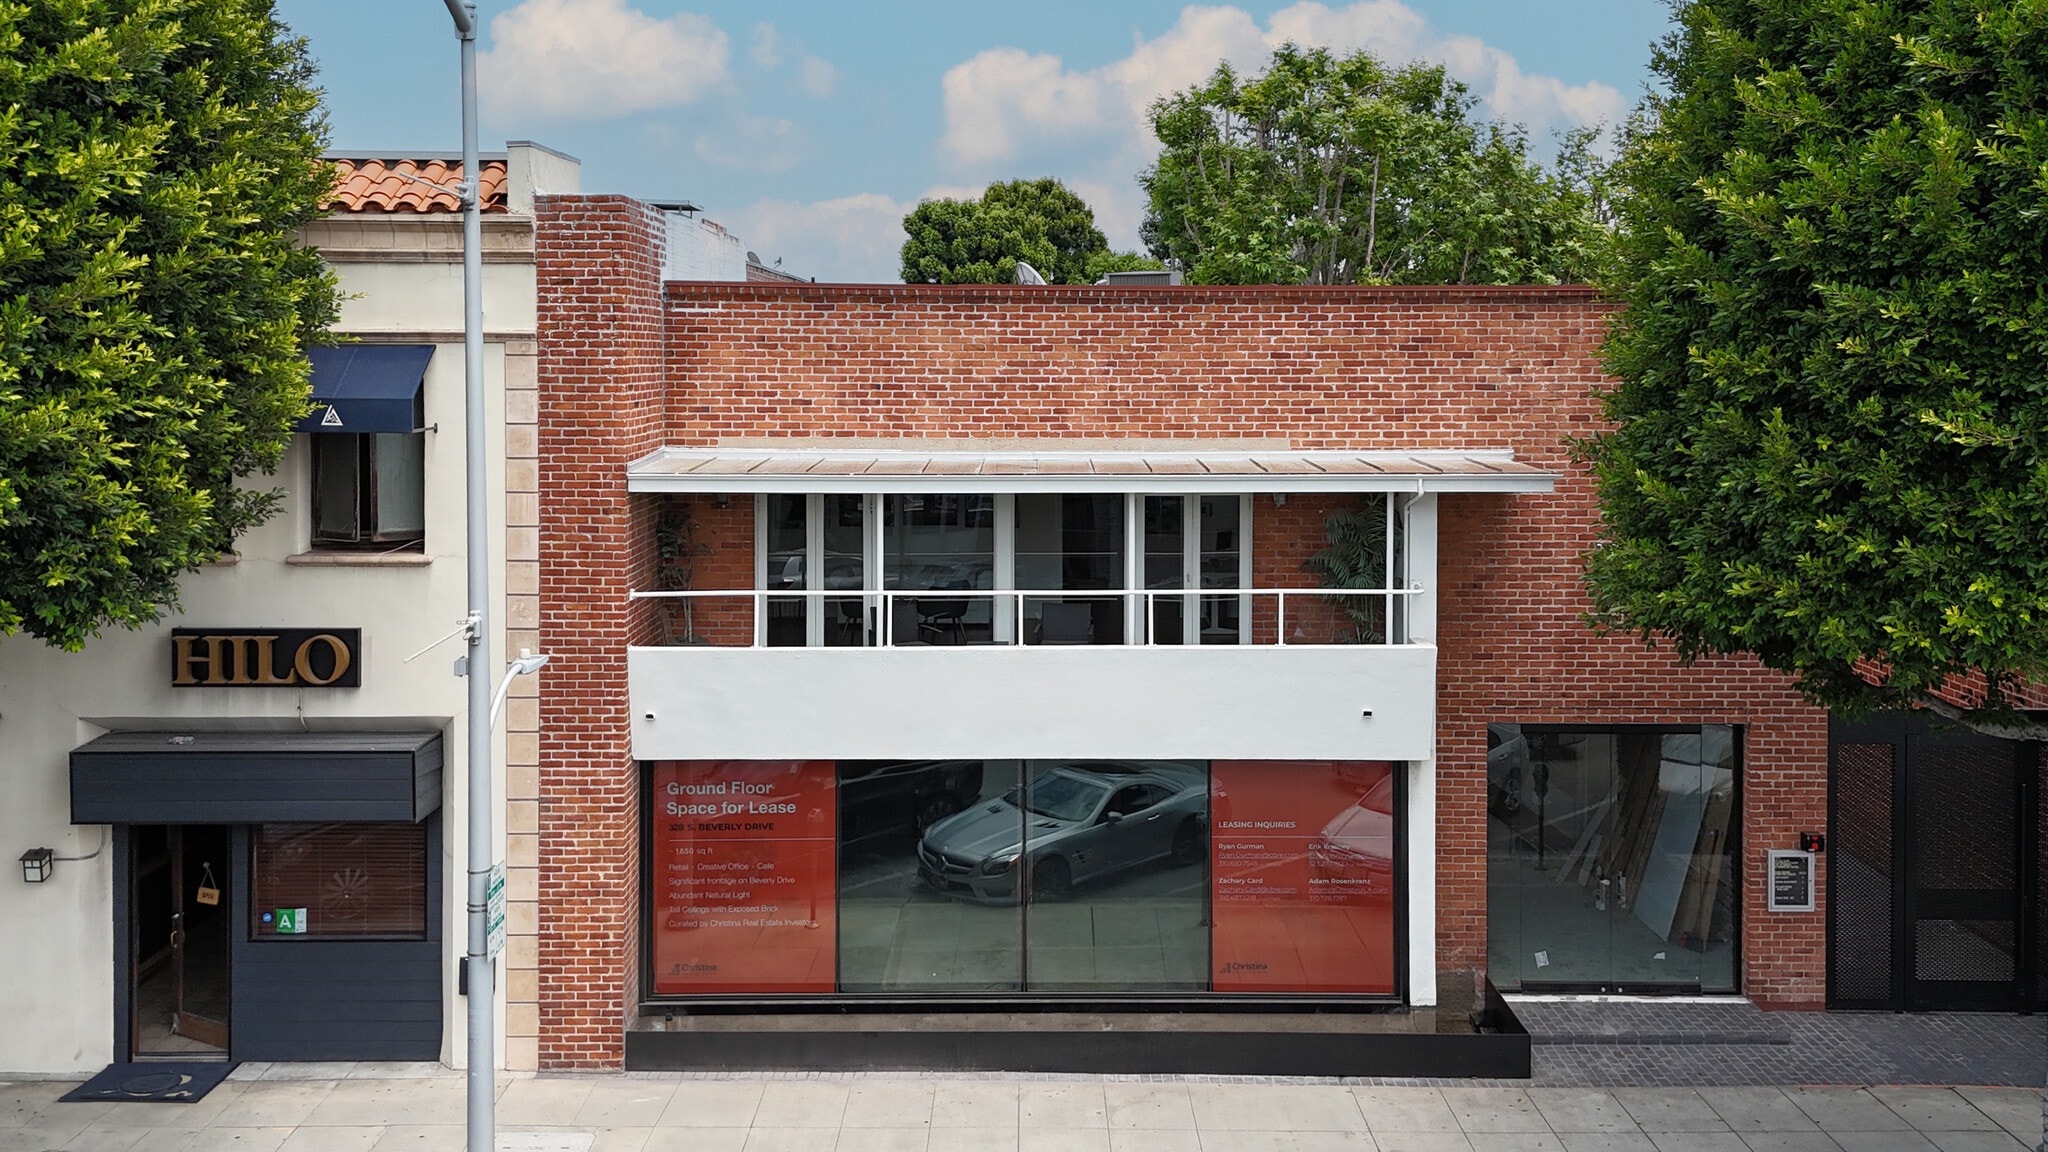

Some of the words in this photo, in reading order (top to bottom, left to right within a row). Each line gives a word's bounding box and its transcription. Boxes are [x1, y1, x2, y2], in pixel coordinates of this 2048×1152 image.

[171, 633, 351, 685] HILO
[666, 781, 727, 795] Ground
[731, 781, 773, 795] Floor
[666, 801, 717, 817] Space
[721, 801, 745, 814] for
[749, 801, 797, 814] Lease
[699, 823, 742, 831] BEVERLY
[1255, 821, 1296, 829] INQUIRIES
[728, 862, 749, 870] Office
[668, 877, 705, 886] Significant
[707, 877, 737, 886] frontage
[749, 877, 775, 885] Beverly
[706, 891, 731, 899] Natural
[733, 891, 750, 900] Light
[682, 905, 710, 914] Ceilings
[728, 905, 760, 914] Exposed
[279, 914, 292, 928] A
[699, 920, 708, 928] by
[710, 919, 741, 927] Christina
[681, 963, 718, 971] Christina
[1232, 962, 1268, 970] Christina
